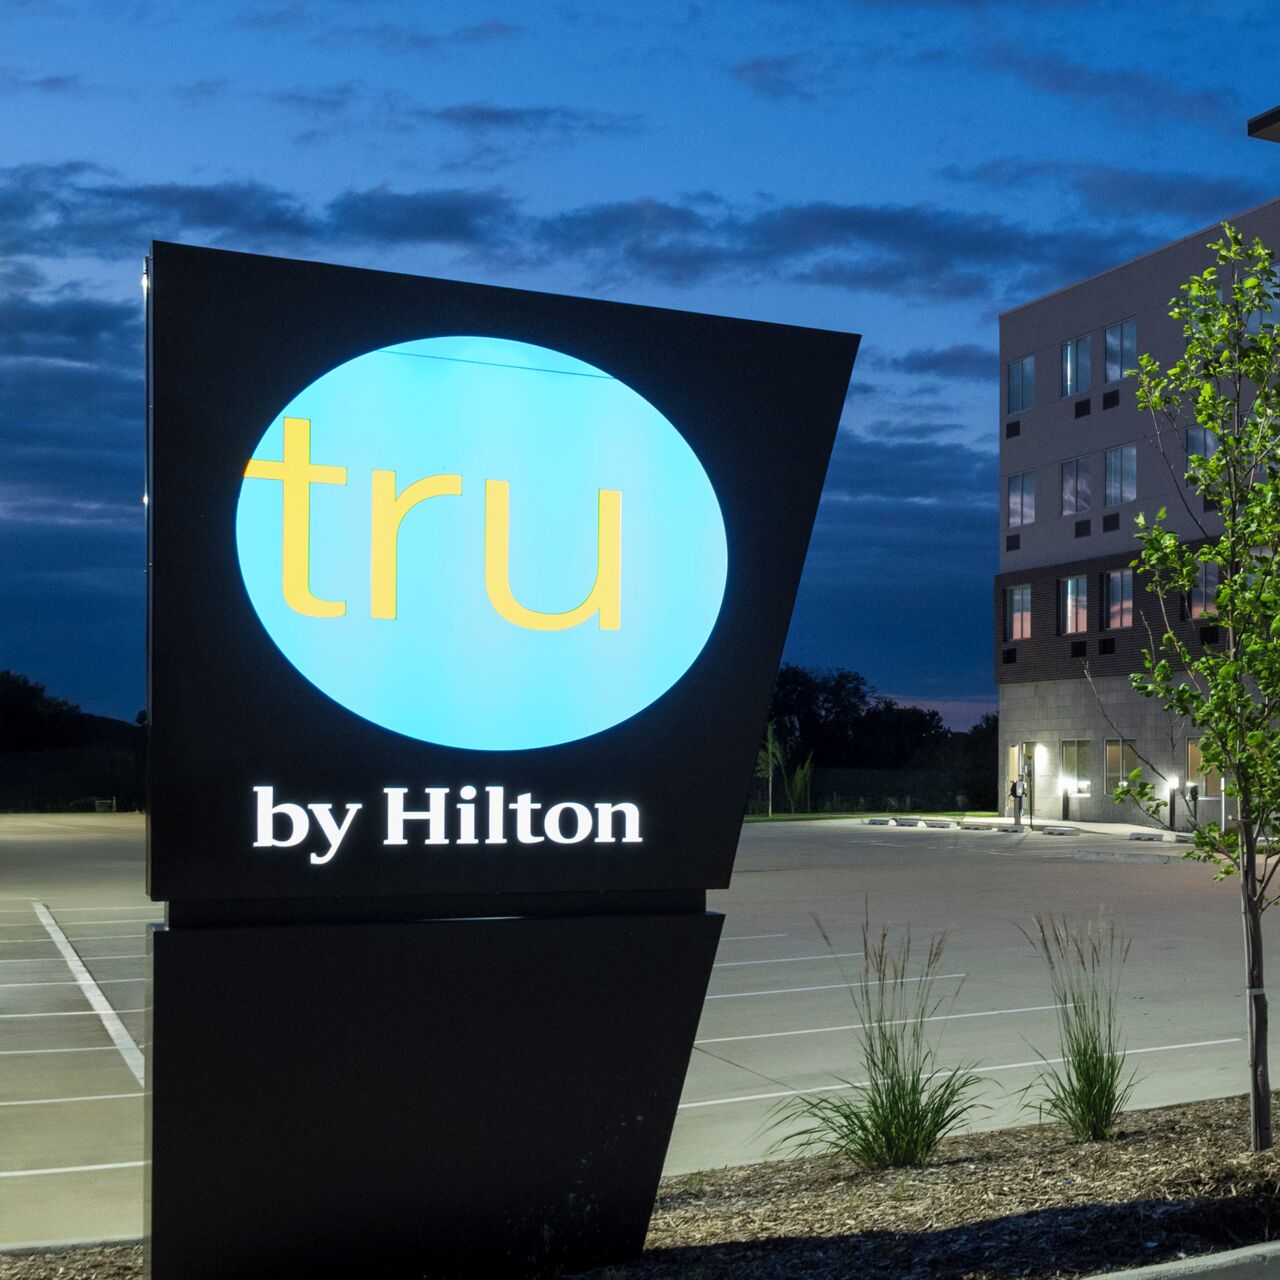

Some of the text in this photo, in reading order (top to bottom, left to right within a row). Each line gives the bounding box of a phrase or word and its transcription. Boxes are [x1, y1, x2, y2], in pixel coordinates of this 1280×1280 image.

[243, 416, 622, 631] tru
[253, 785, 643, 865] by Hilton
